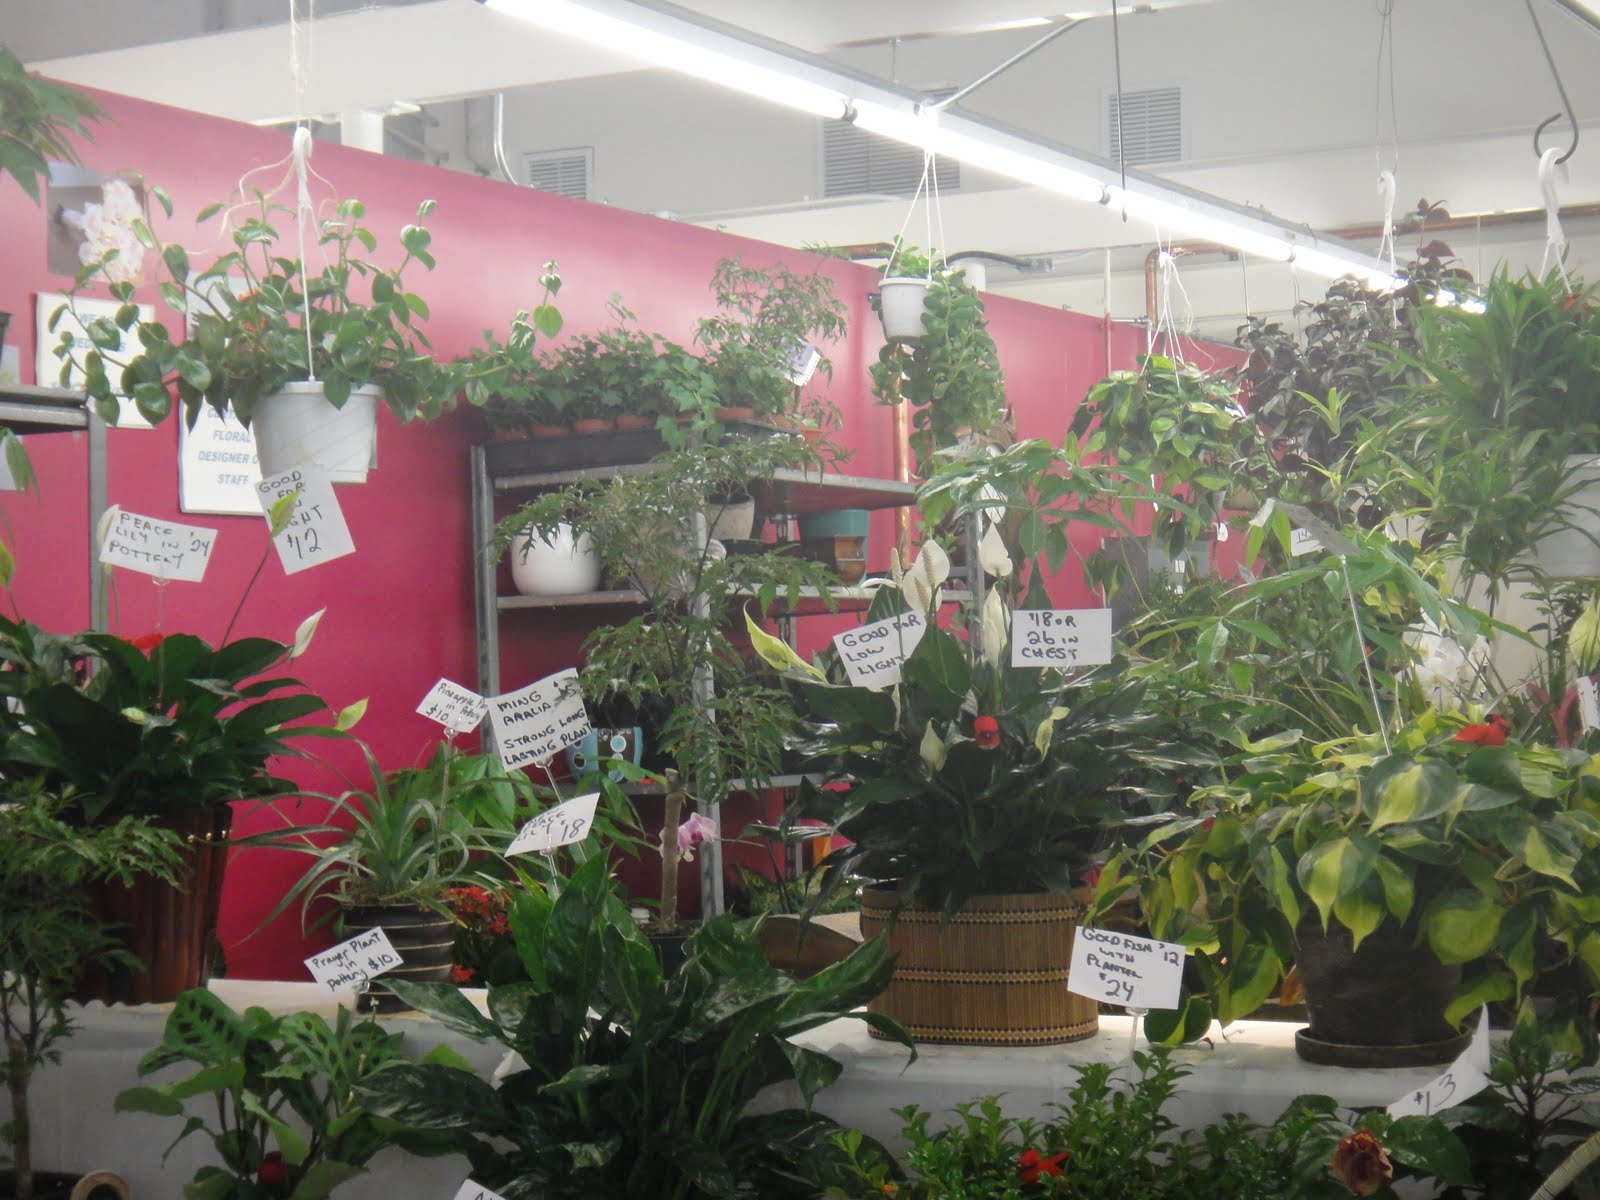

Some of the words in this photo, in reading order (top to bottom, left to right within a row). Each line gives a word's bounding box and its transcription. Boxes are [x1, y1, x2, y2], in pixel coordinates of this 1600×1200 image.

[213, 430, 252, 443] FLORAL
[198, 450, 250, 464] DESIGNER
[217, 474, 249, 486] STAFF
[259, 470, 302, 493] GOOD
[120, 512, 173, 536] PEACE
[115, 526, 148, 544] LILY
[162, 540, 180, 550] IN
[842, 626, 889, 647] GOOD
[845, 645, 885, 662] LOW
[857, 654, 905, 675] LIGHT
[1021, 647, 1077, 660] CHEST
[497, 690, 542, 713] MING
[503, 701, 551, 727] ARALIA
[504, 724, 556, 750] STRONG
[559, 707, 585, 727] LONG
[504, 738, 557, 766] LASTING
[560, 722, 593, 747] PLANT
[311, 948, 348, 969] Prayer
[349, 931, 381, 953] Plant
